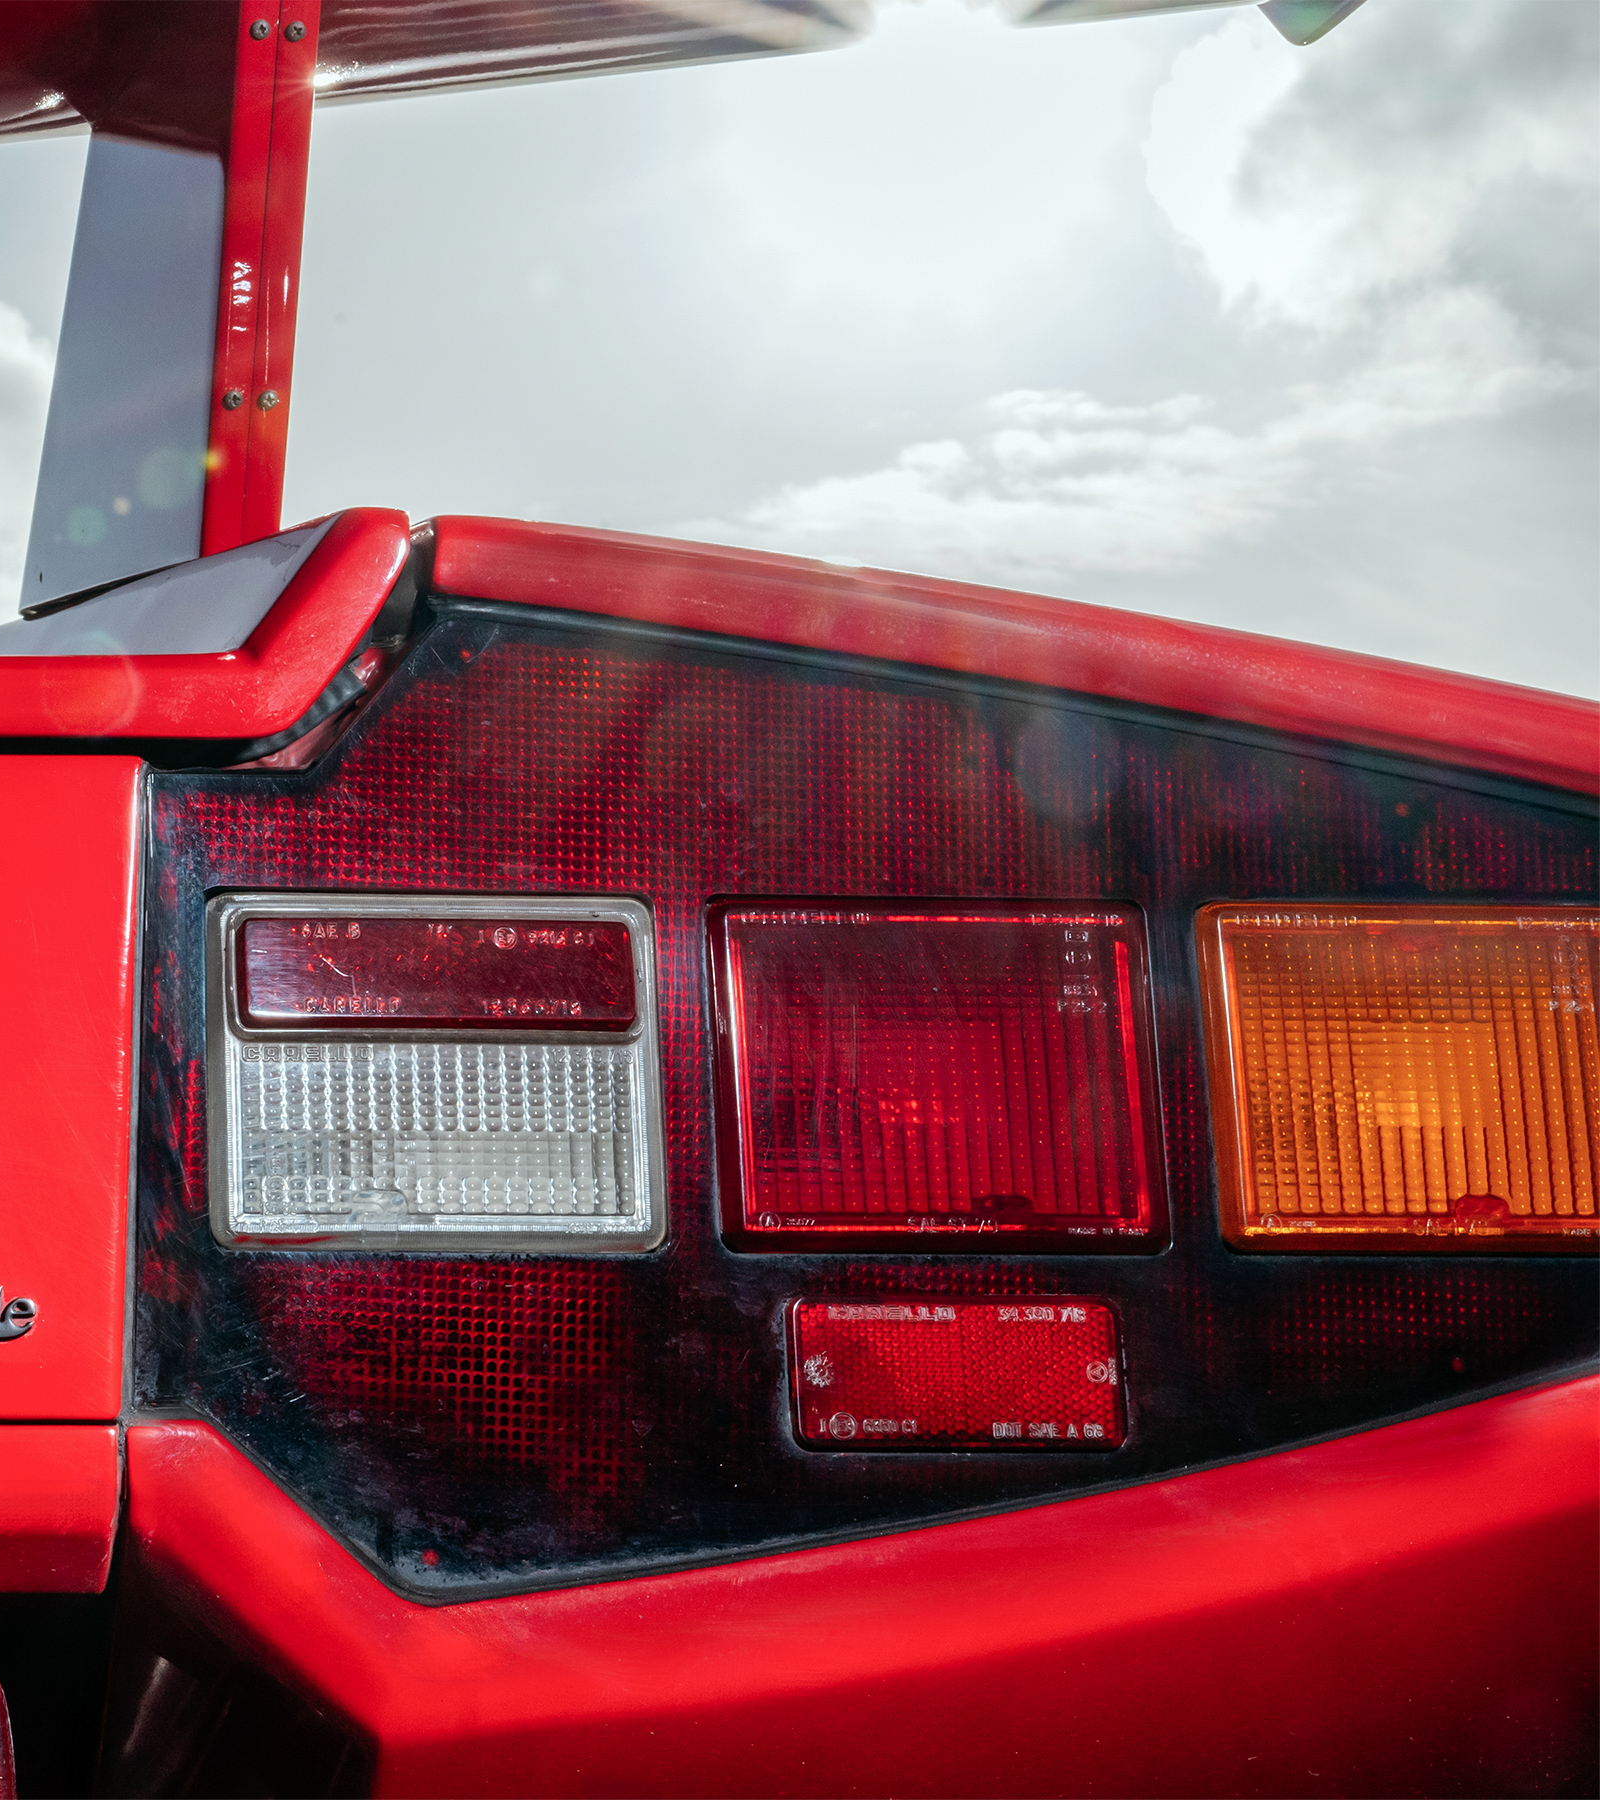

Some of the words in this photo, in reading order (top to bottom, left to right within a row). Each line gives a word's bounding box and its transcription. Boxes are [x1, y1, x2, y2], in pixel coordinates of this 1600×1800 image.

[302, 922, 338, 939] SAE
[349, 922, 361, 939] B
[305, 996, 402, 1015] CARELLO
[242, 1044, 375, 1063] CARELLO
[907, 1216, 940, 1234] SAE
[828, 1305, 956, 1322] CARELLO
[992, 1422, 1022, 1440] DOT
[1029, 1422, 1061, 1439] SAE
[1066, 1423, 1079, 1439] A
